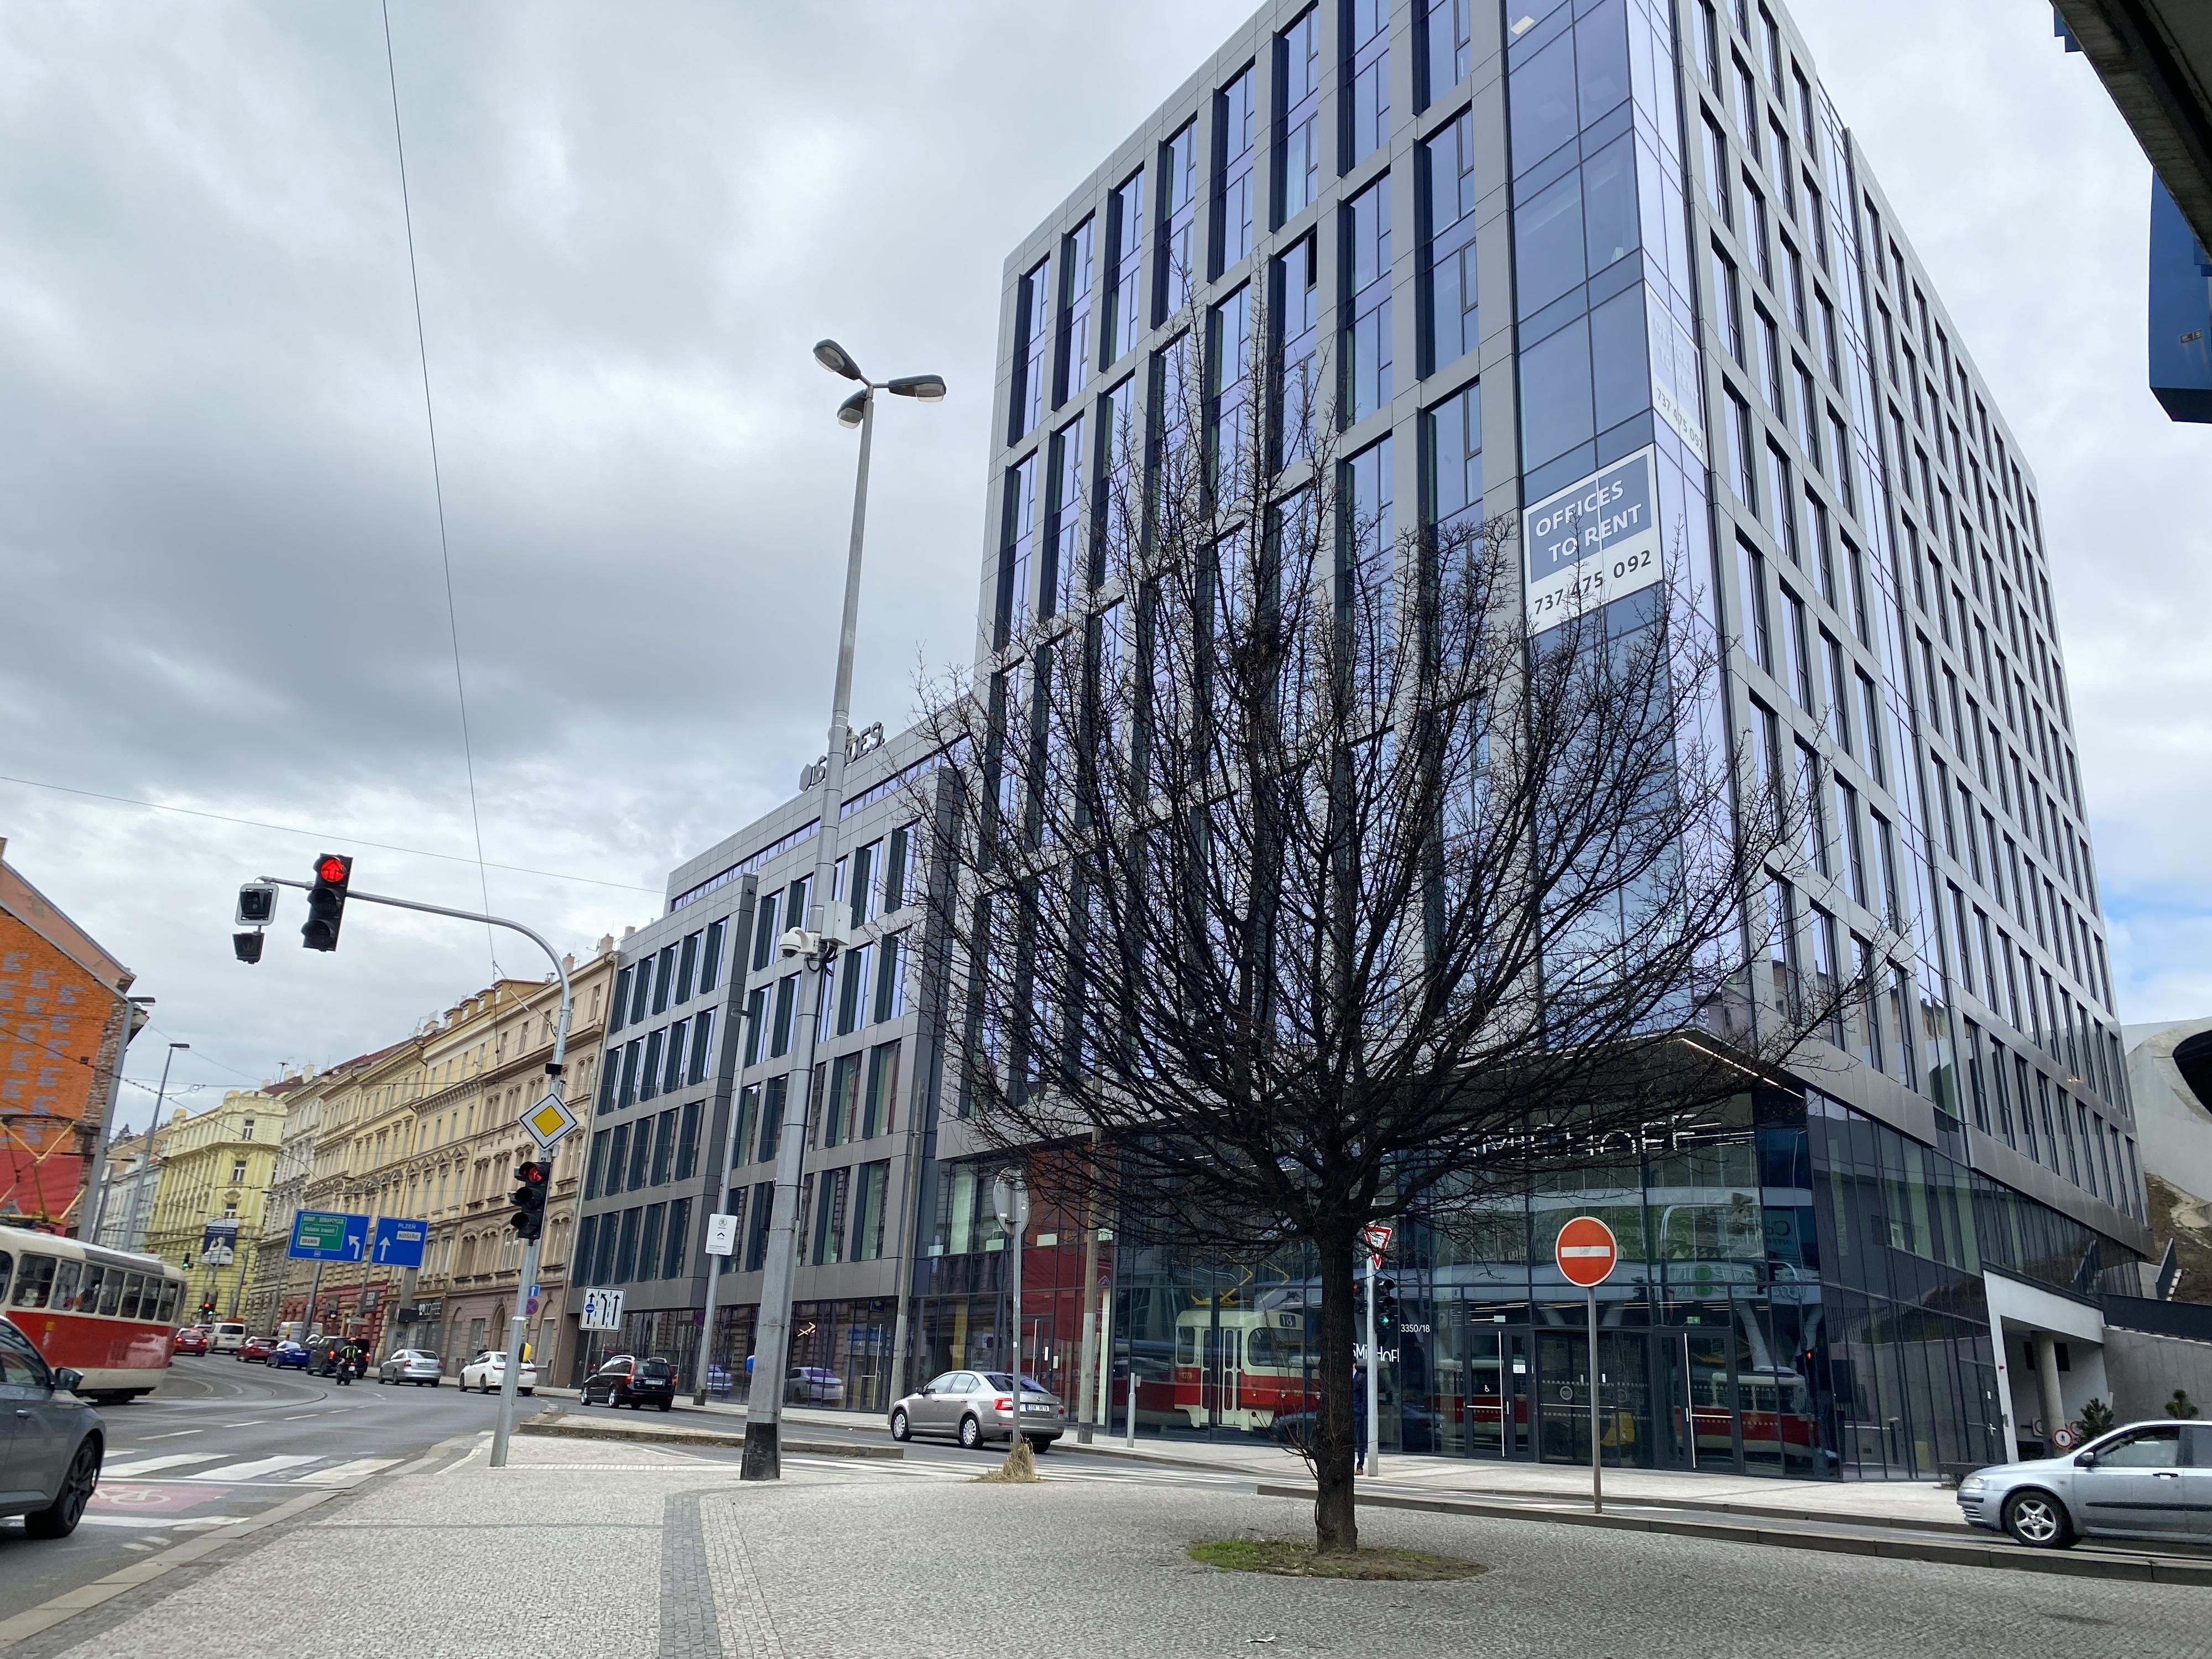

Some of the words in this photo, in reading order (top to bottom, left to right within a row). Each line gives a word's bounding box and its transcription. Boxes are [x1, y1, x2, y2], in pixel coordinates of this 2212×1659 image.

[1657, 387, 1670, 411] 737
[1673, 408, 1687, 433] 475
[1689, 427, 1703, 453] 092
[1535, 479, 1624, 537] OFFICES
[1548, 536, 1577, 562] TO
[1584, 503, 1642, 547] RENT
[1534, 588, 1564, 615] 737
[1569, 570, 1603, 600] 475
[1614, 549, 1651, 578] 092
[1400, 1324, 1430, 1333] 3350/18
